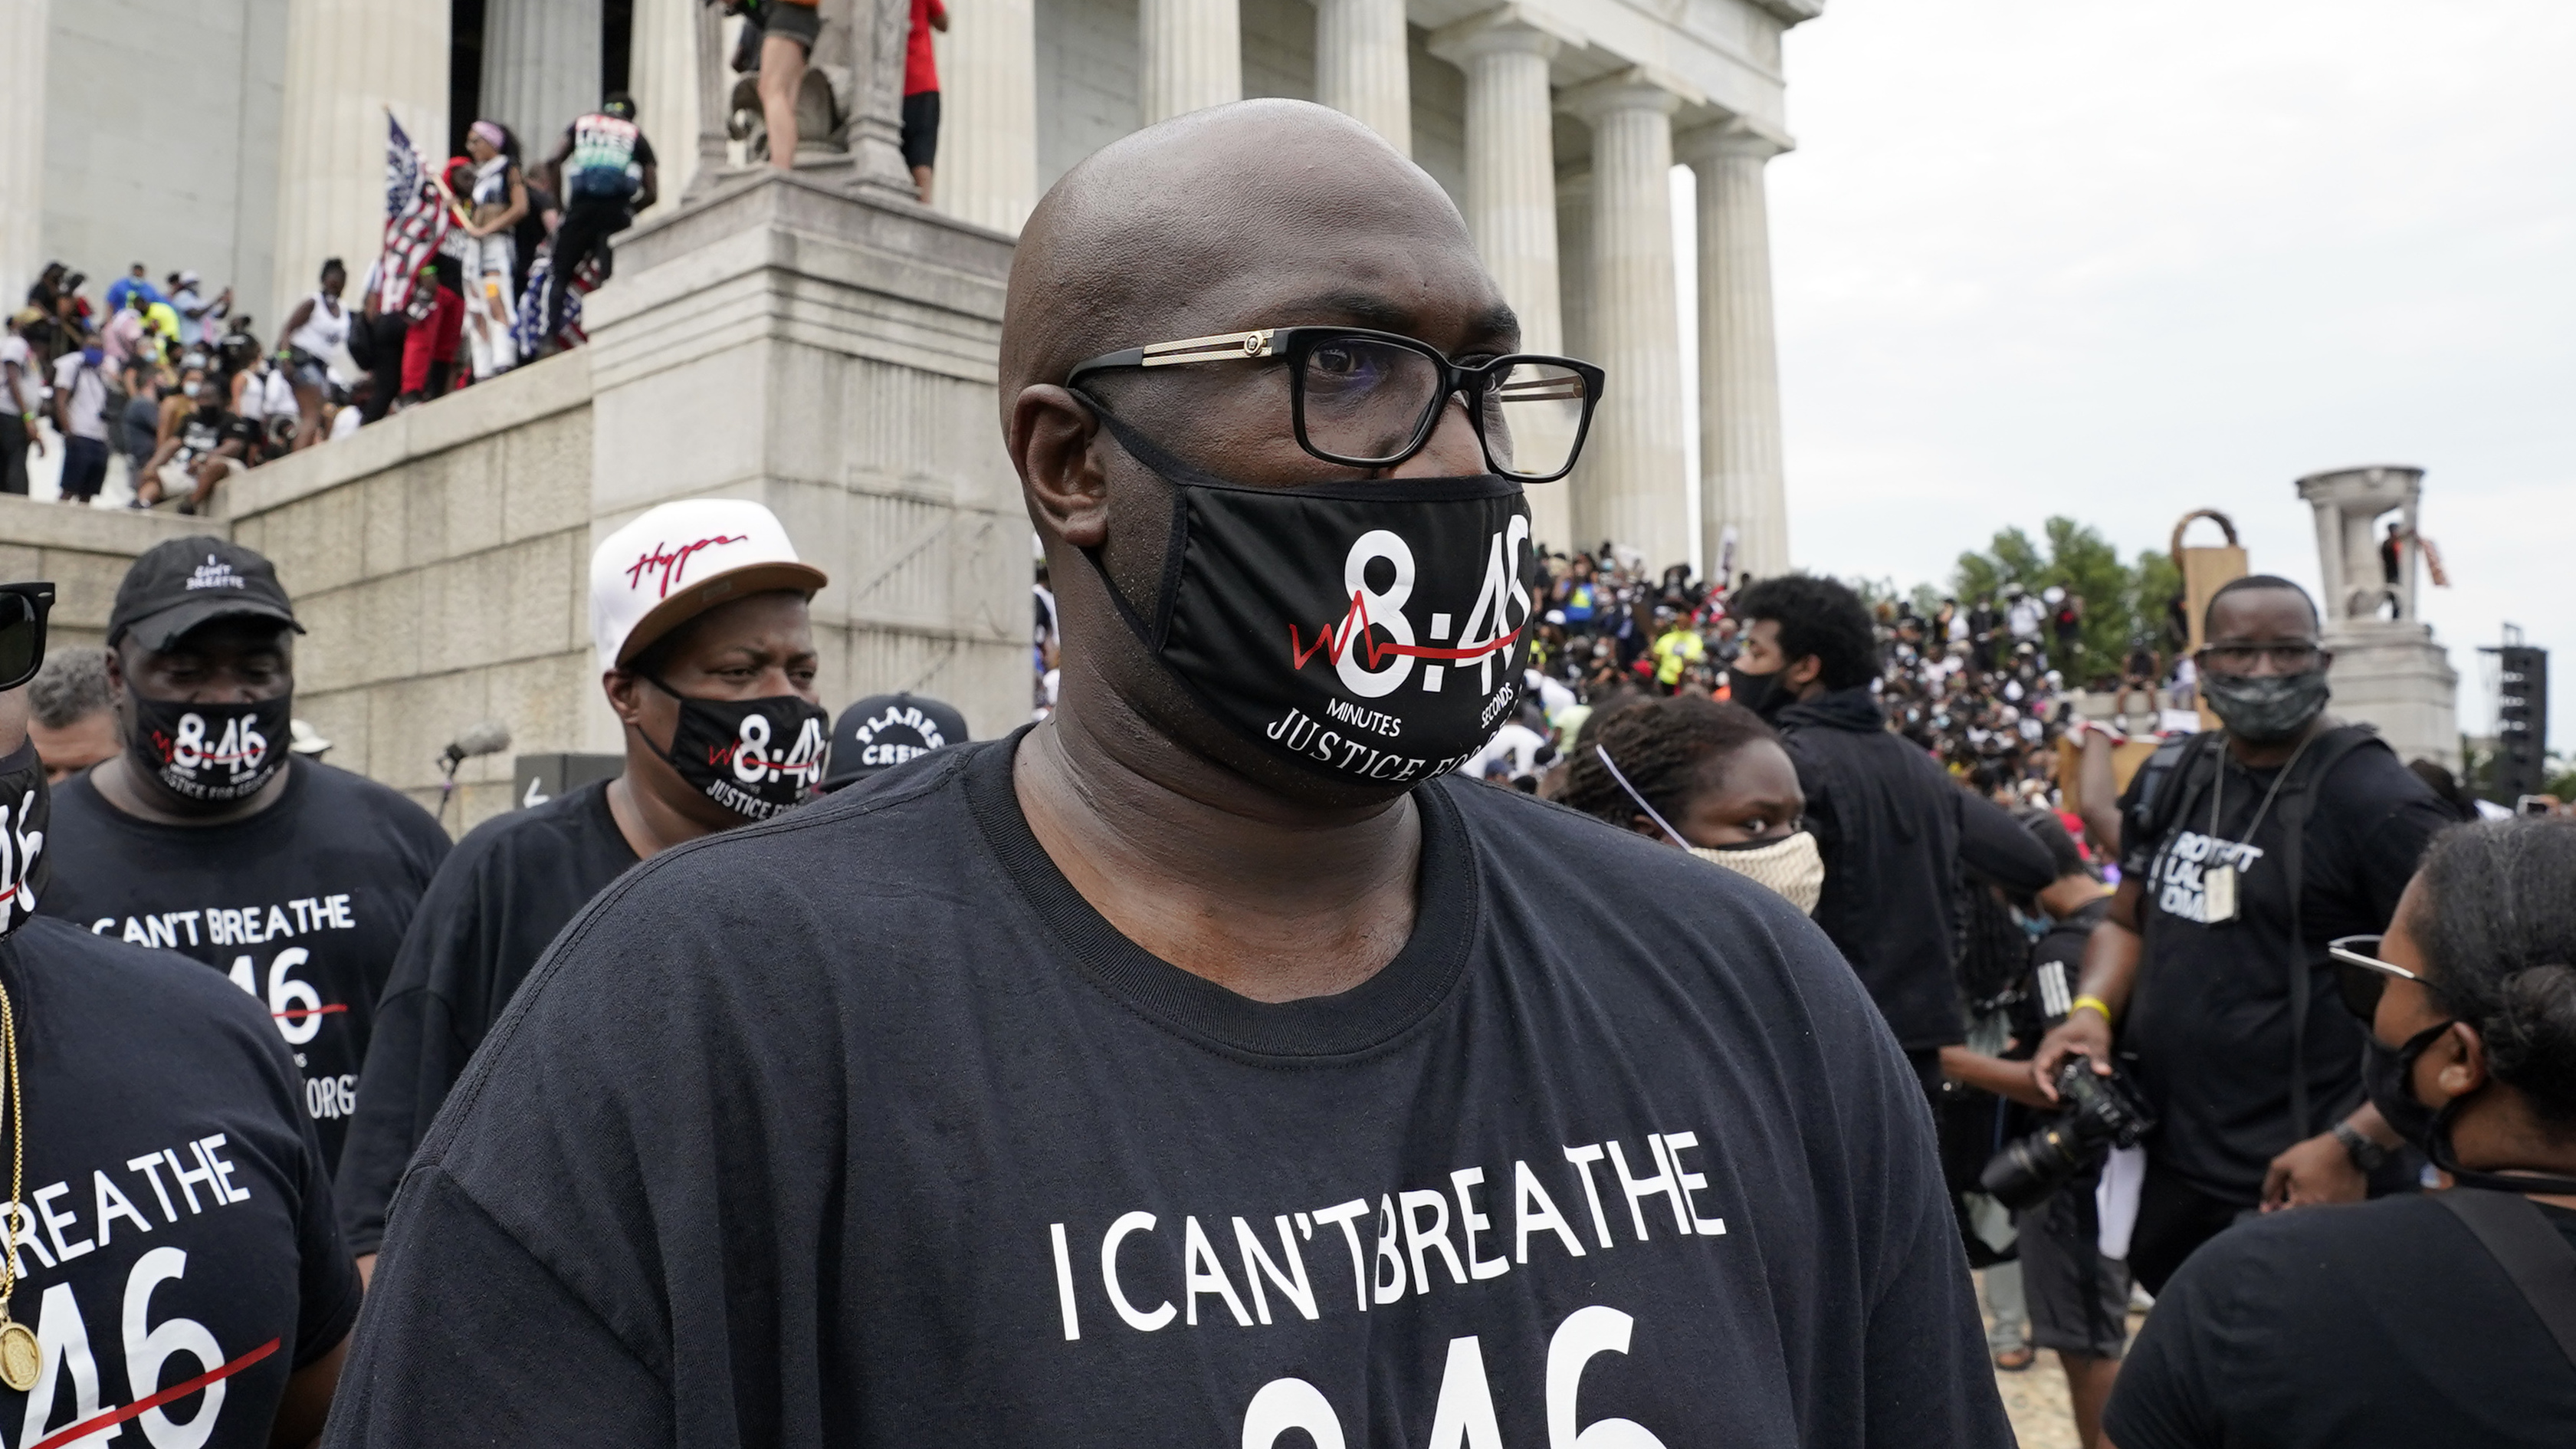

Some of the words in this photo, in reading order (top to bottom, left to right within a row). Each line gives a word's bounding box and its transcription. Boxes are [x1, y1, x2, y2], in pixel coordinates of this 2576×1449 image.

[1334, 514, 1532, 698] 8:46
[1325, 698, 1403, 738] MINUTES
[1481, 681, 1514, 729] SECONDS
[173, 712, 267, 774] 8:46
[1266, 707, 1426, 782] JUSTICE
[705, 778, 773, 820] JUSTICE
[205, 894, 356, 946] BREATHE
[0, 1133, 251, 1280] REATHE
[1050, 1223, 1081, 1341] I
[1101, 1198, 1370, 1332] CAN'T
[1373, 1132, 1728, 1305] BREATHE
